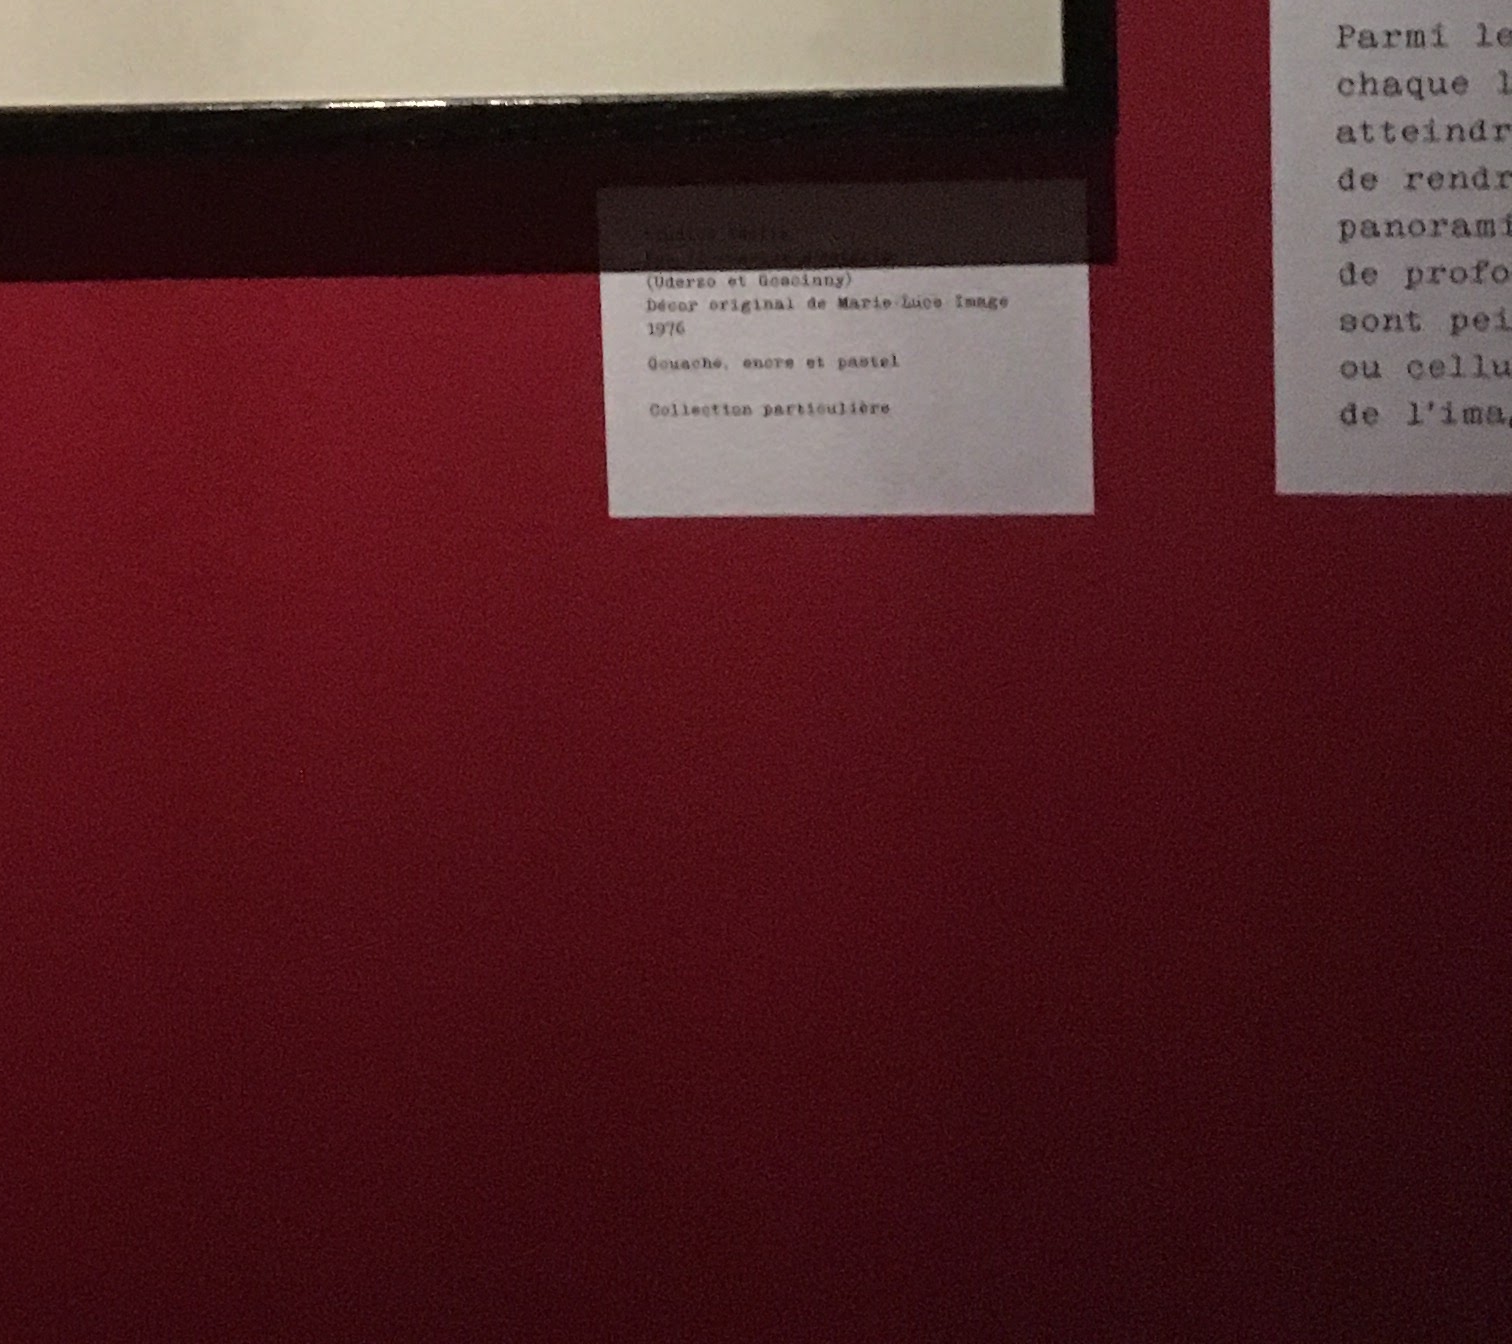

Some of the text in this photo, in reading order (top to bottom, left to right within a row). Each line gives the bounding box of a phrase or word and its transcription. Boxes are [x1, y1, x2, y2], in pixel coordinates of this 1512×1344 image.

[1336, 22, 1512, 50] Parmi le
[1336, 71, 1469, 102] chaque
[1335, 118, 1512, 145] atteindr
[1337, 166, 1512, 192] de rendr
[645, 275, 718, 293] (Uderzo
[726, 272, 748, 290] et
[1338, 259, 1512, 291] de profo
[707, 294, 796, 315] original
[805, 294, 828, 312] de
[646, 319, 689, 338] 1976
[1339, 307, 1512, 338] sont pei
[740, 354, 796, 372] encre
[804, 352, 827, 371] et
[837, 352, 900, 371] pastel
[1339, 353, 1512, 381] ou cellu
[649, 398, 891, 418] Collection particulière
[1339, 400, 1512, 429] de l'ima
